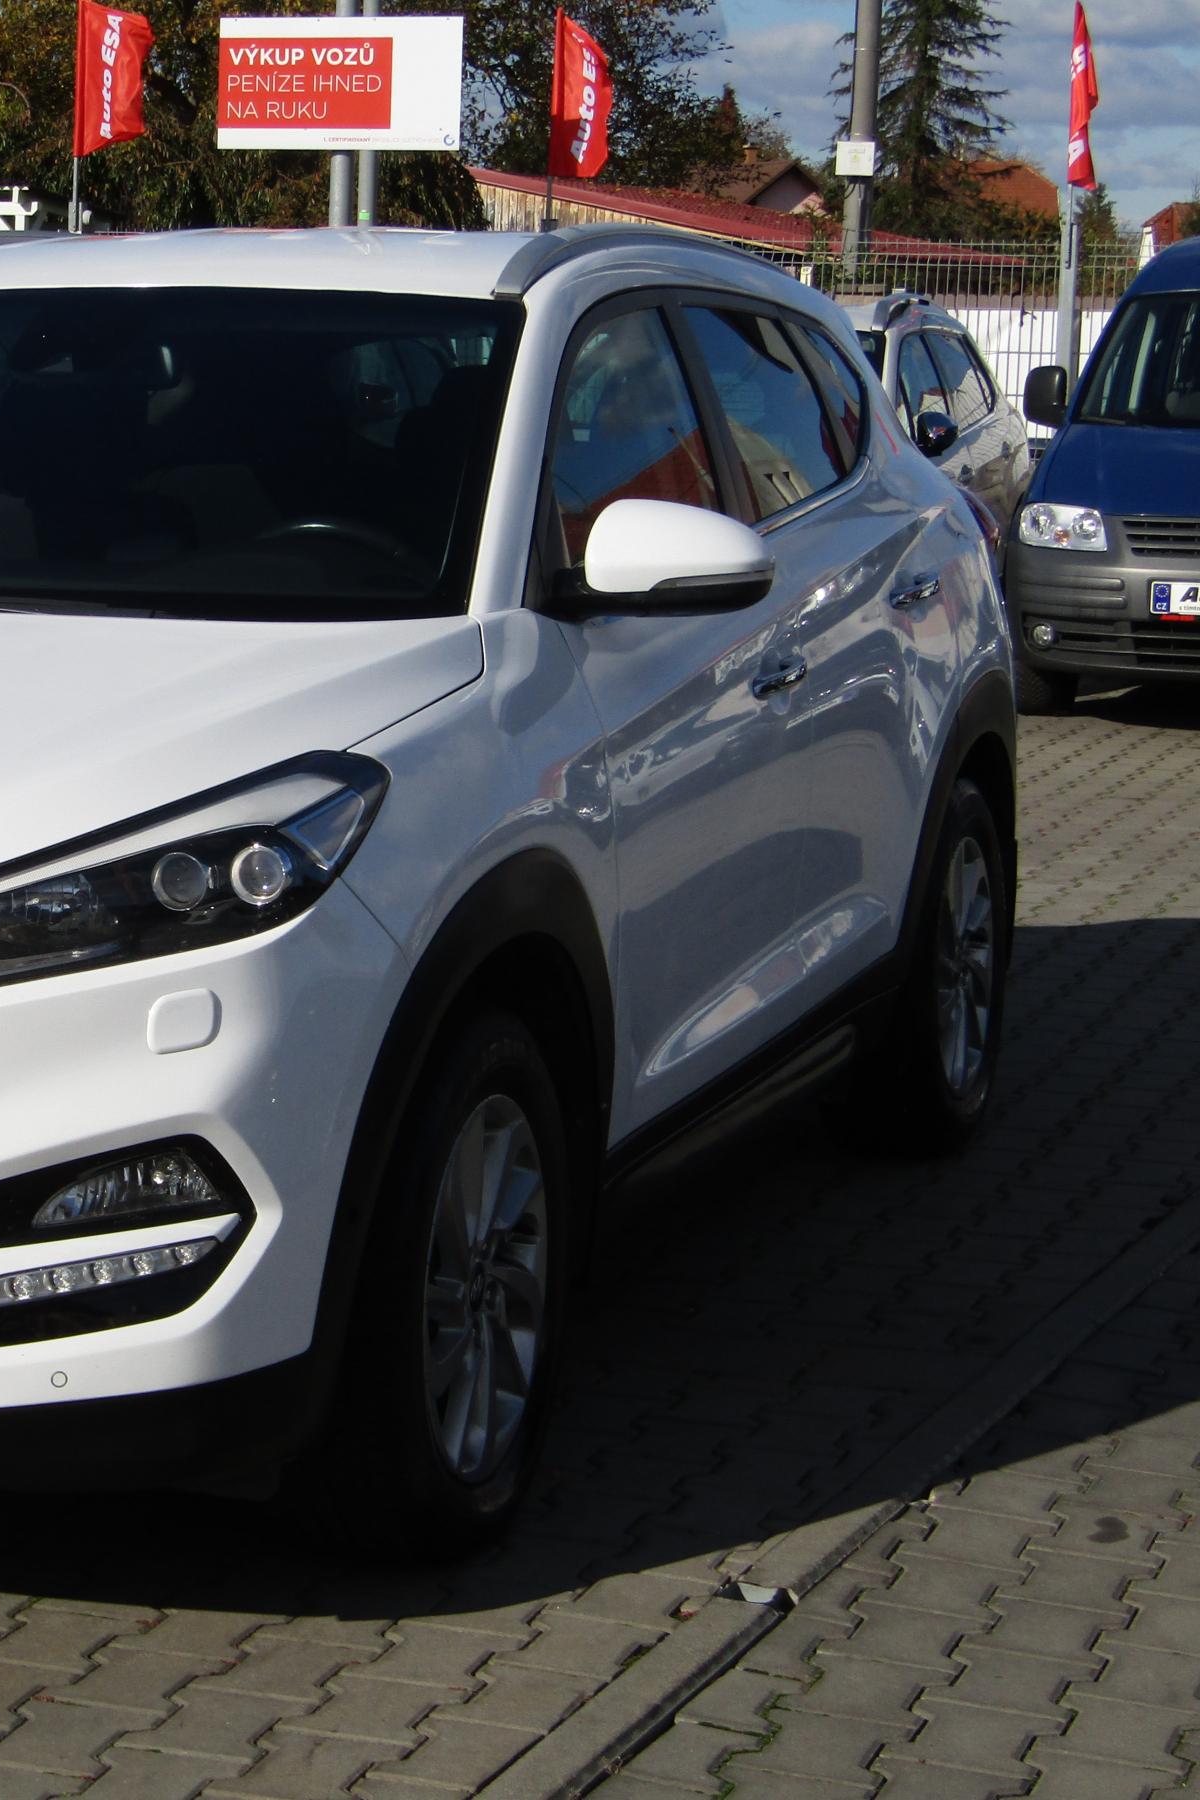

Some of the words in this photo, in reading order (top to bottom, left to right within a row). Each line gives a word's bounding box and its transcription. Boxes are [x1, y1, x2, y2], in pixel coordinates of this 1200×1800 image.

[101, 13, 124, 67] ESA
[229, 44, 305, 66] VÝKUP
[311, 42, 375, 66] VOZŮ
[227, 71, 306, 93] PENÍZE
[313, 74, 383, 93] IHNED
[99, 68, 113, 140] Auto
[226, 101, 259, 120] NA
[266, 101, 328, 120] RUKU
[570, 85, 596, 165] Auto
[1155, 602, 1167, 611] CZ
